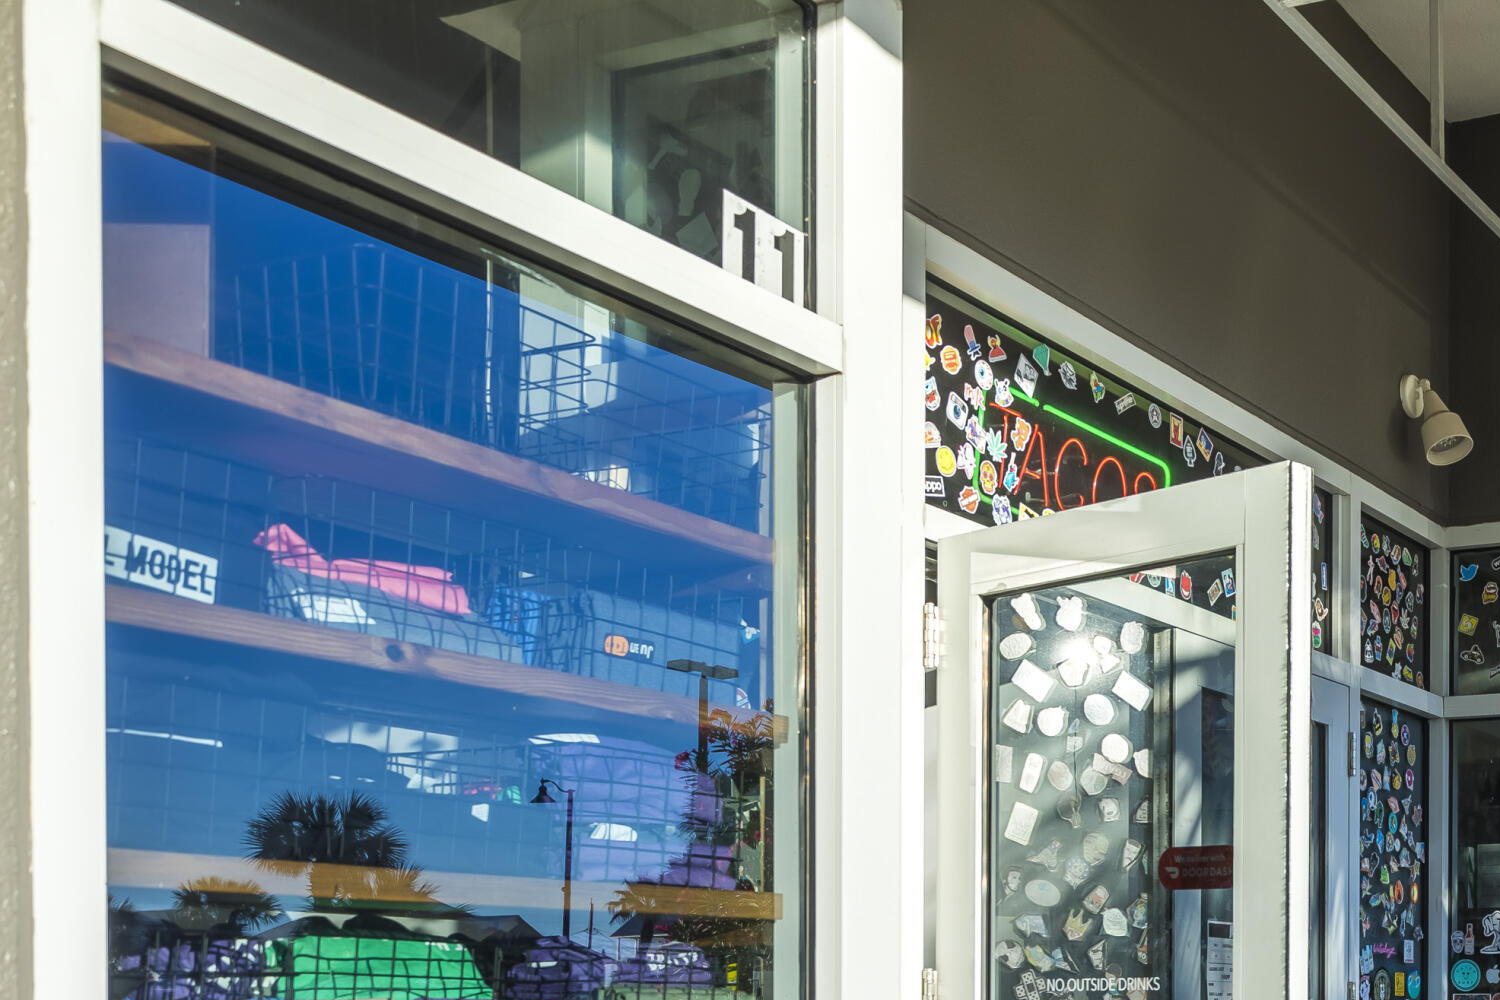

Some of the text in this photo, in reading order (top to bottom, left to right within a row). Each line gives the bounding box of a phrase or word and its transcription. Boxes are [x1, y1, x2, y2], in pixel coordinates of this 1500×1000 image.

[125, 540, 213, 596] MODEL
[1046, 976, 1161, 992] NO OUTSIDE DRINKS
